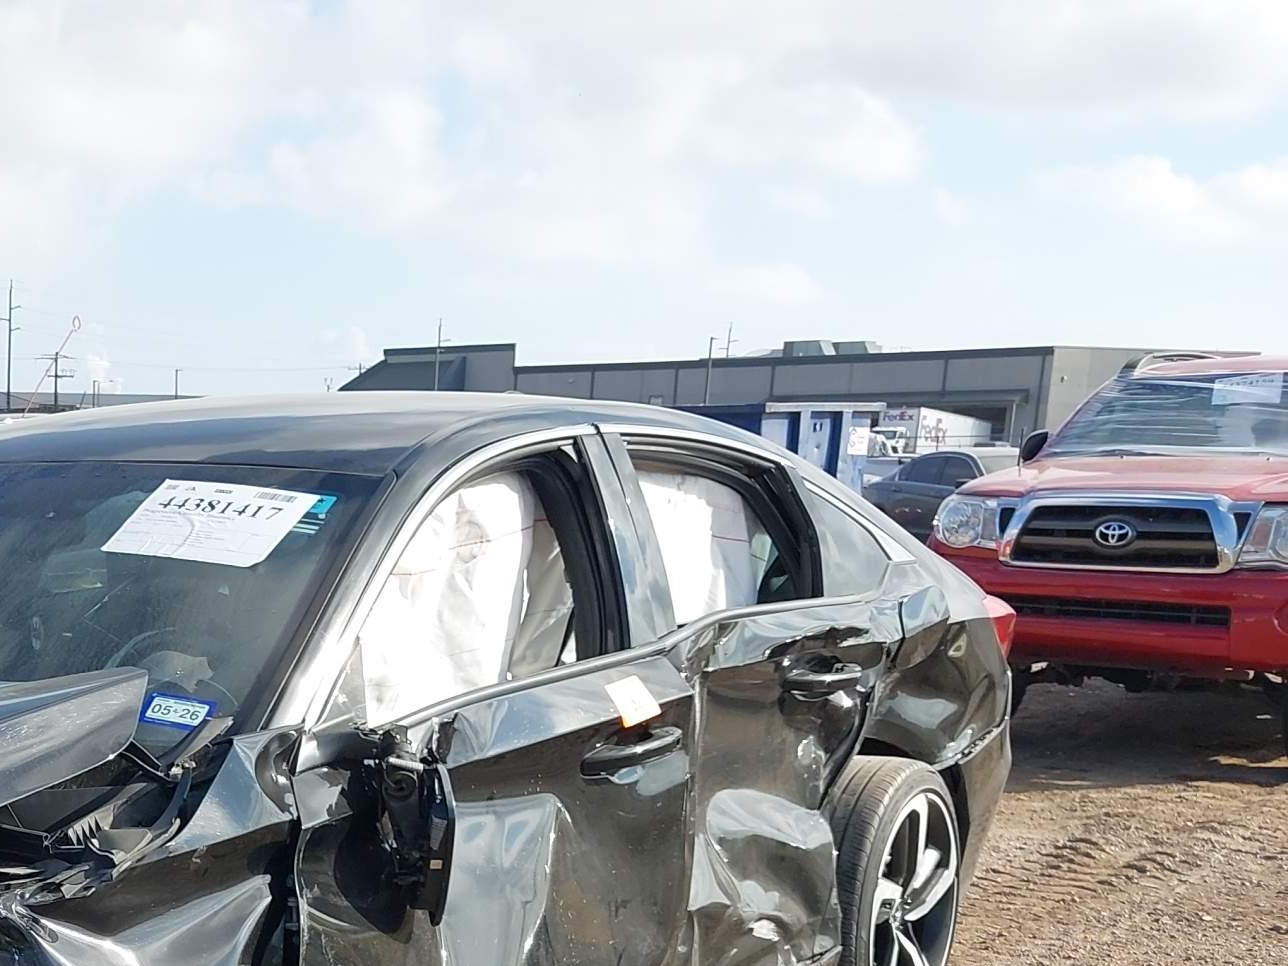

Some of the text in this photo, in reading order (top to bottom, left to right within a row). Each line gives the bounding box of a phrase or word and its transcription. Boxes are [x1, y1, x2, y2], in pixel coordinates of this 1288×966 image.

[883, 410, 915, 422] FedEx
[920, 415, 948, 445] FedEx
[158, 496, 284, 521] 44381417
